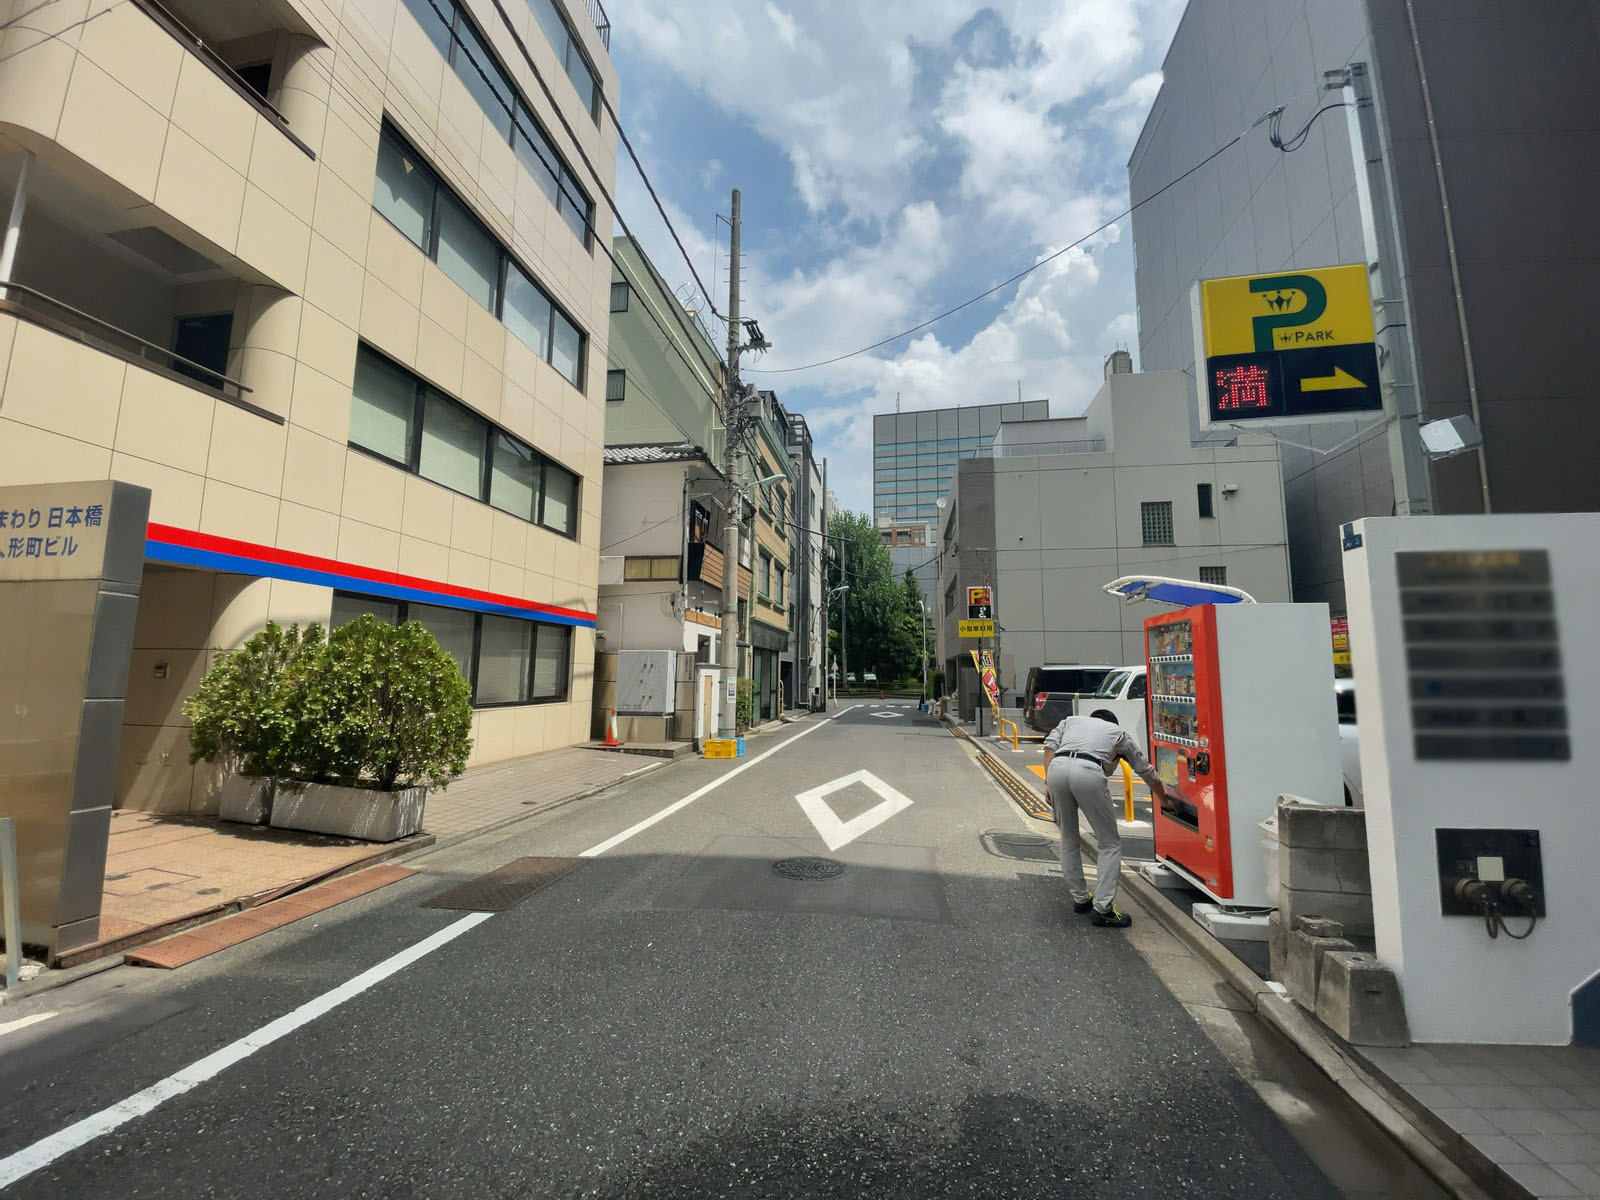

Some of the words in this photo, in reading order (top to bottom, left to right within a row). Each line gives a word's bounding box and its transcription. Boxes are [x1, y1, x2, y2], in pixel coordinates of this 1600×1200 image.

[1249, 275, 1327, 352] P
[1295, 330, 1335, 343] PARK
[1216, 365, 1269, 410] 満
[48, 505, 103, 528] 日本橋
